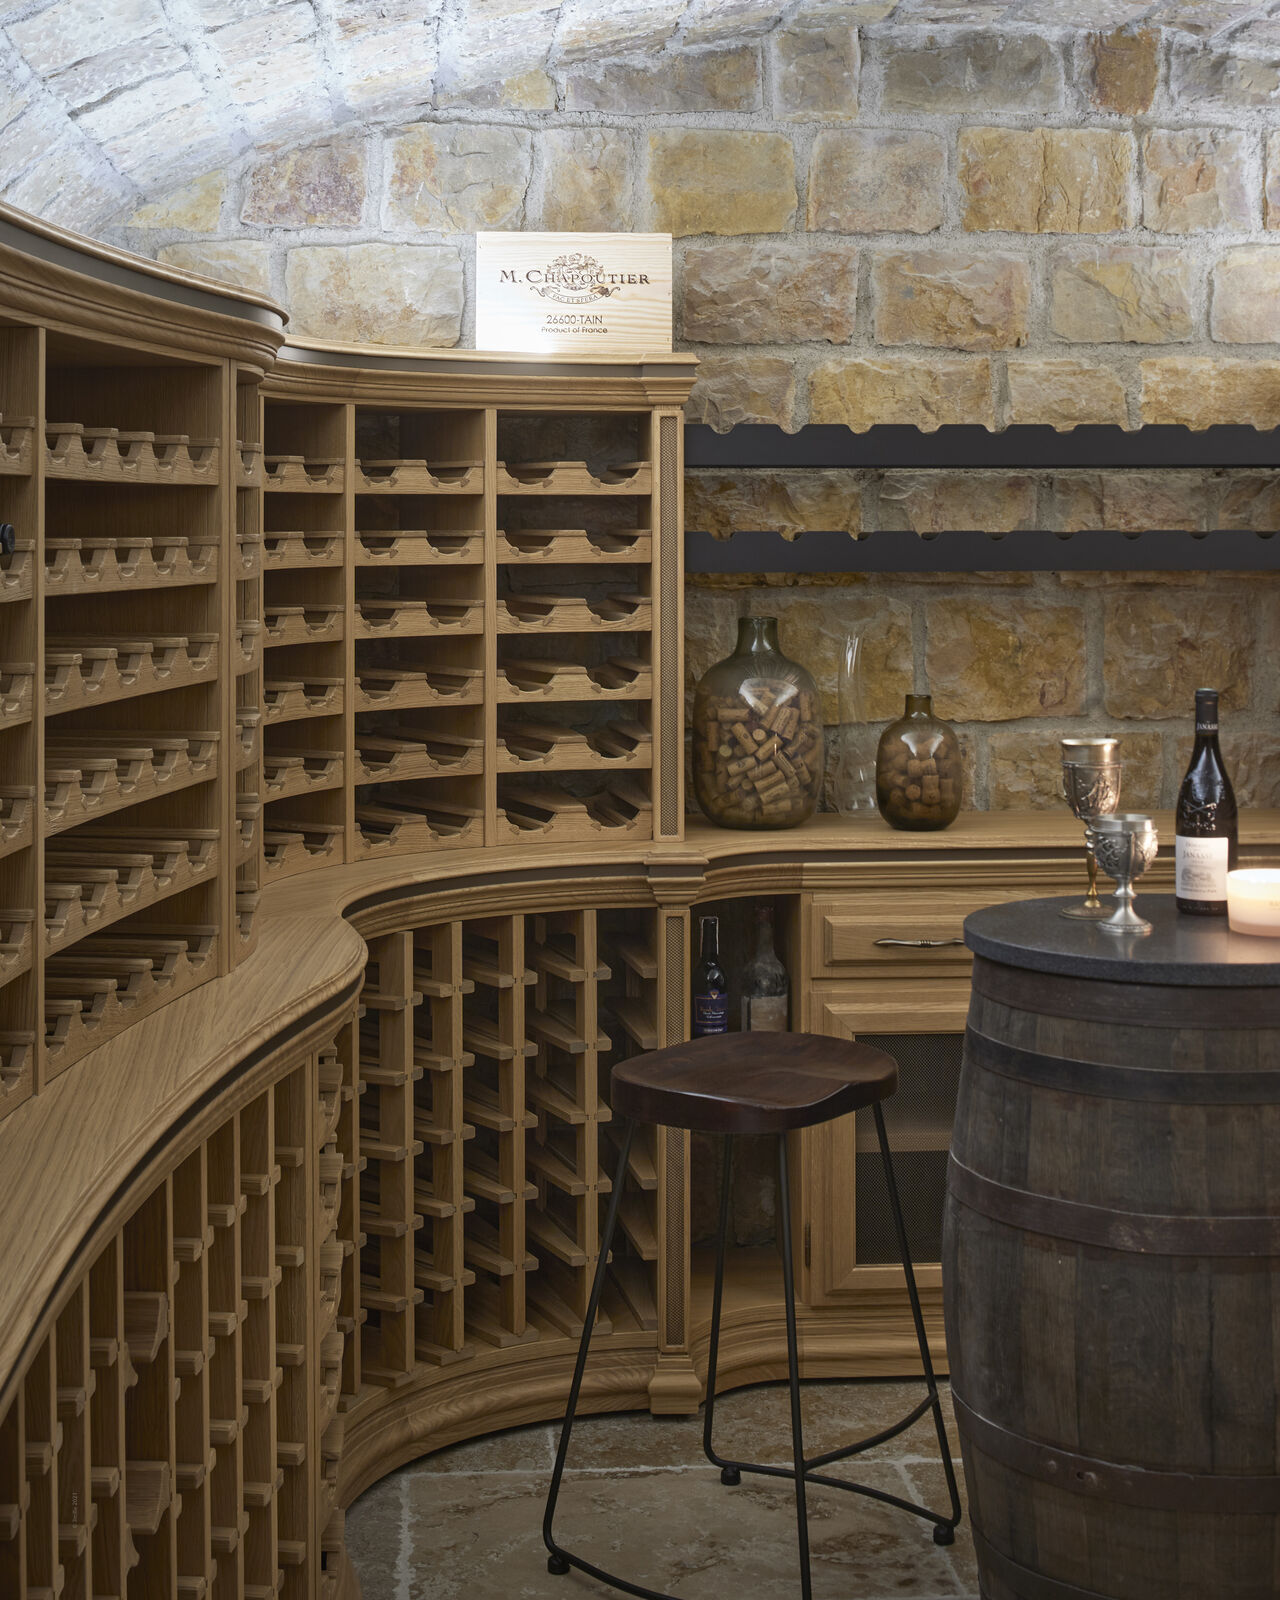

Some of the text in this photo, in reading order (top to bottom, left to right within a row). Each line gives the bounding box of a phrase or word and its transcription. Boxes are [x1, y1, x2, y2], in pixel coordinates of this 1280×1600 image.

[499, 270, 651, 285] M. CHAPOUTIER
[546, 315, 603, 325] 26600-TAIN
[541, 326, 608, 334] Product of France
